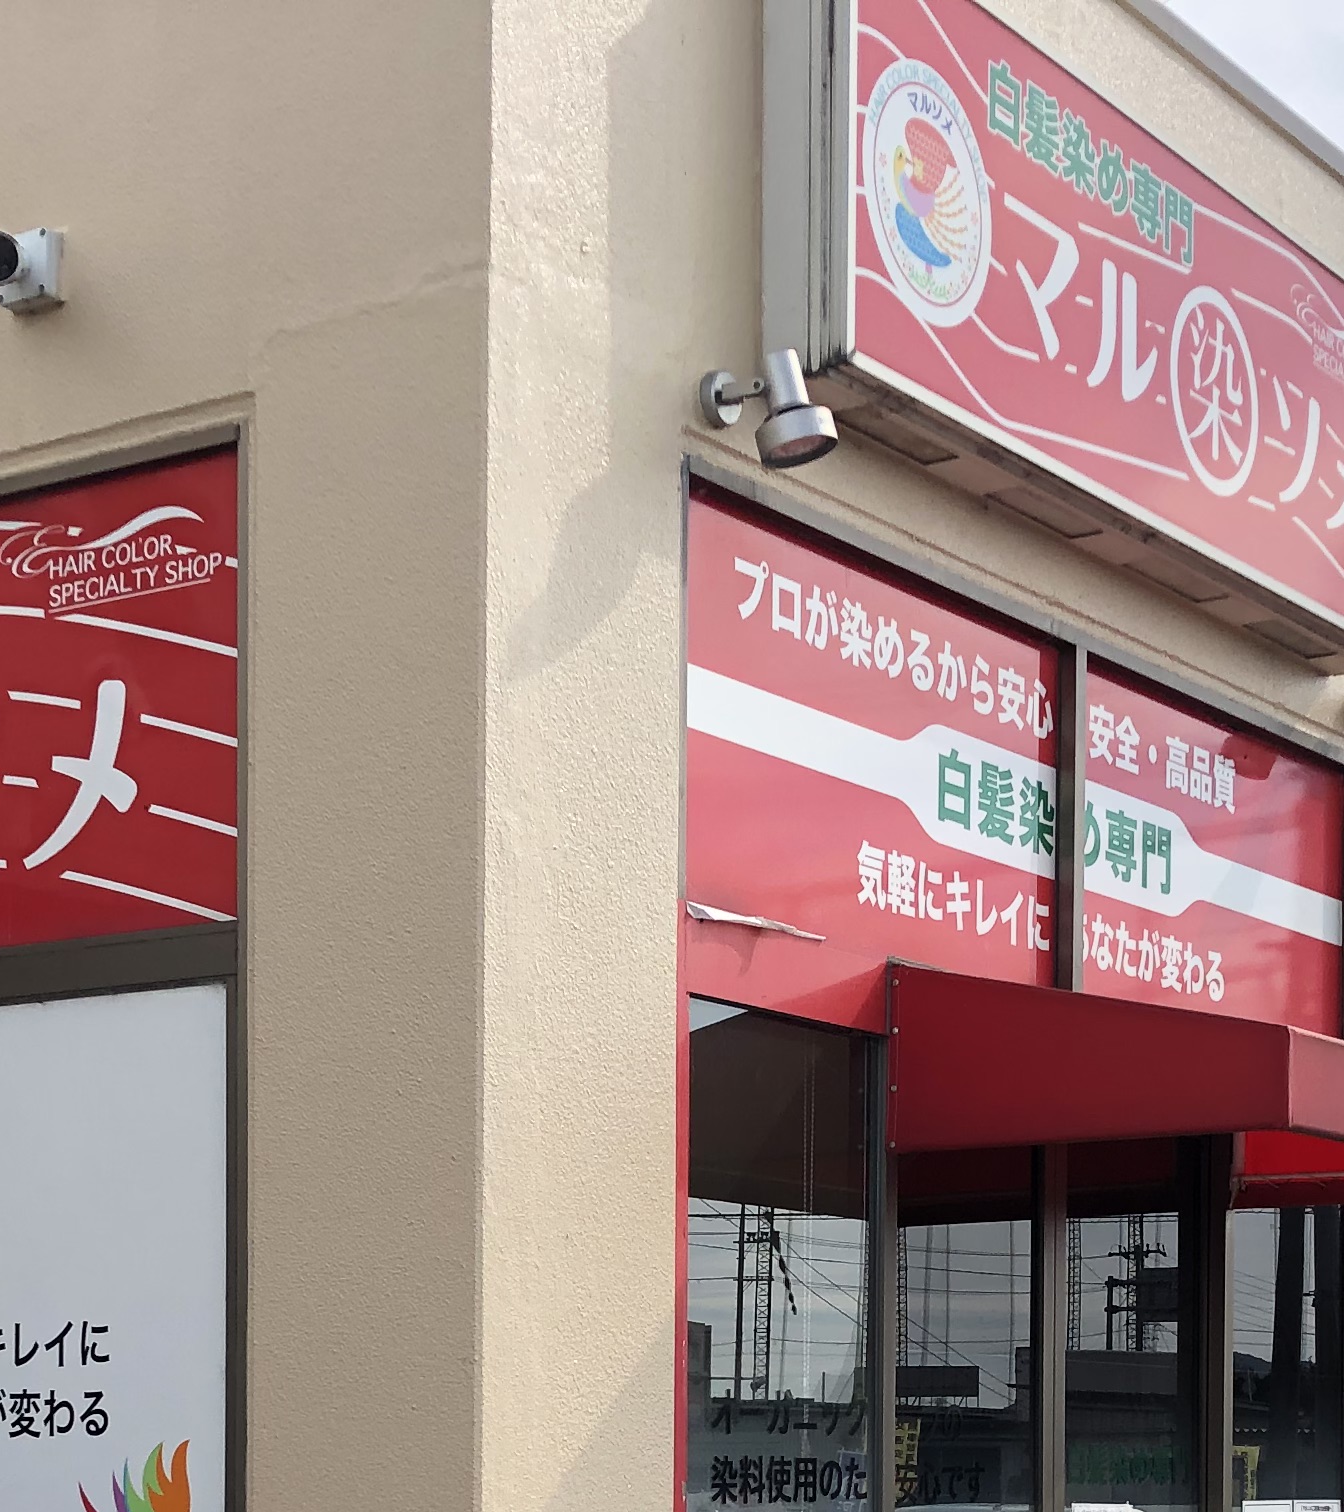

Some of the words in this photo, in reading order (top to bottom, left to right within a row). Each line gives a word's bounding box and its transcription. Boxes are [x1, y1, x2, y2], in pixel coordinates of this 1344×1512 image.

[888, 64, 920, 90] COLOR
[907, 91, 953, 136] マルソメ
[987, 59, 1195, 266] 白髪染め専門
[1312, 321, 1335, 350] HAIR
[49, 549, 96, 580] HAIR
[101, 534, 172, 569] COLOR
[49, 565, 158, 607] SPECIALTY
[164, 552, 222, 584] SHOP
